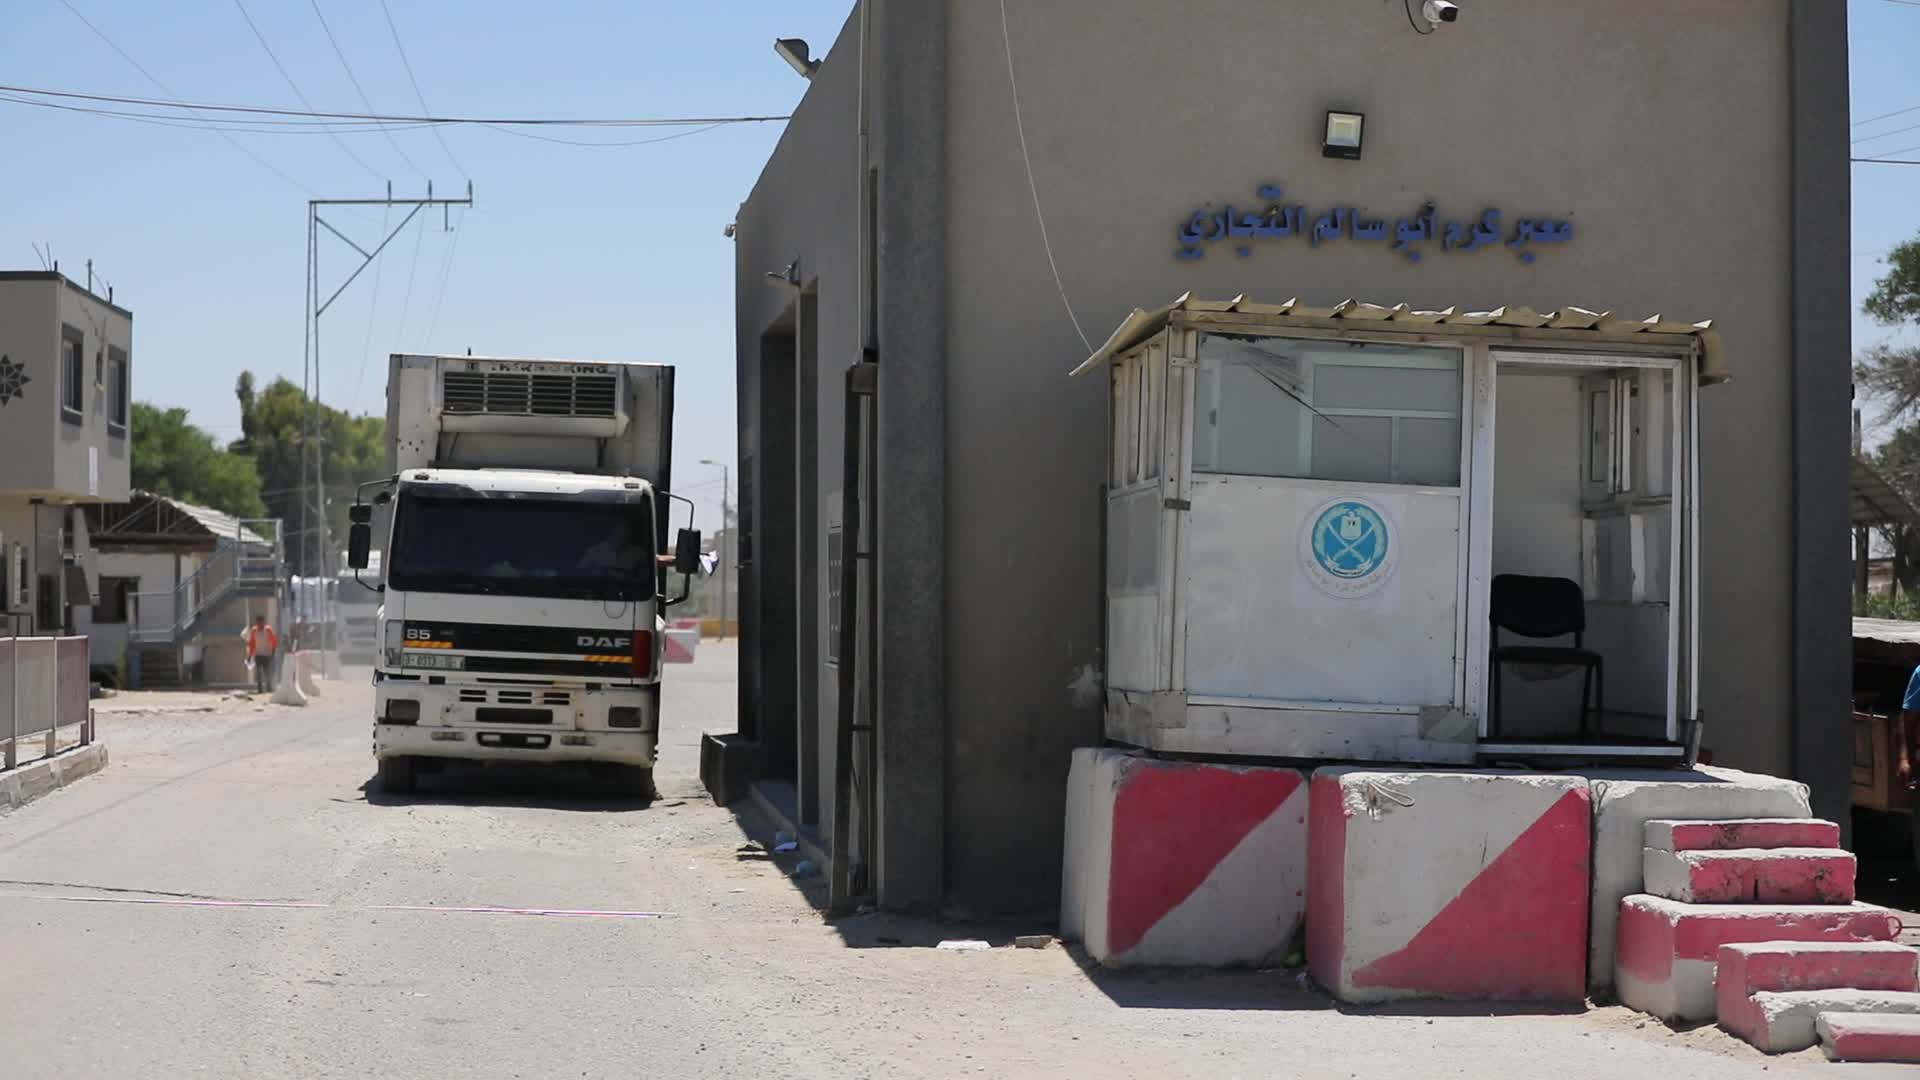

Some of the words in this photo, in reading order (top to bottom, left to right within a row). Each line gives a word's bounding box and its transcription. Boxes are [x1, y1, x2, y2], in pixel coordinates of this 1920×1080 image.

[1176, 186, 1304, 260] التجاري
[1312, 207, 1388, 249] سالم
[1391, 200, 1438, 264] أبو
[1441, 208, 1503, 254] كرم
[1505, 219, 1573, 265] معبر
[407, 628, 431, 640] 85
[577, 636, 631, 648] DAF
